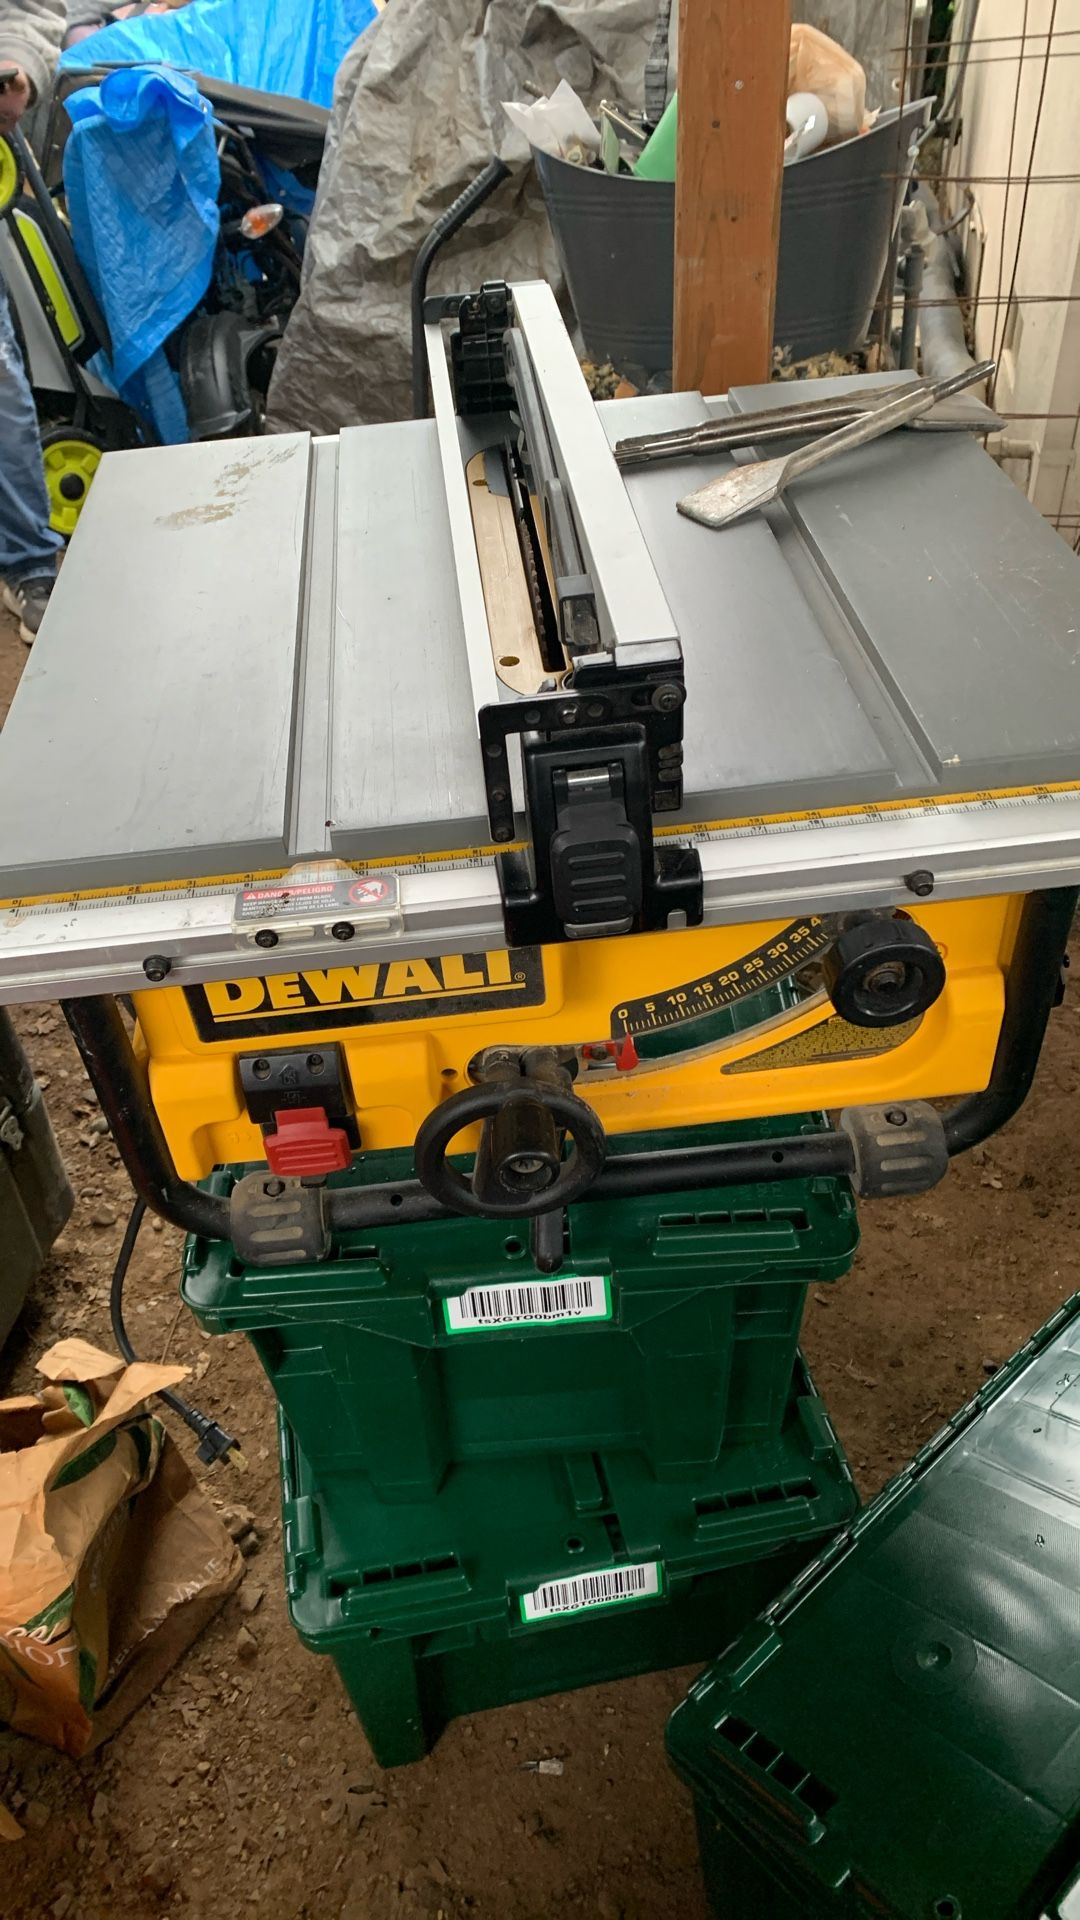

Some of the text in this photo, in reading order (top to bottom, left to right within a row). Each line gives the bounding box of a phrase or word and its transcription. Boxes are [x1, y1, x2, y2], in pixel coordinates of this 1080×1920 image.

[618, 1008, 629, 1019] 0
[645, 1002, 656, 1012] 5
[667, 992, 687, 1006] 10
[693, 983, 714, 995] 15
[718, 970, 740, 986] 20
[743, 957, 764, 973] 25
[767, 942, 789, 959] 30
[789, 925, 810, 943] 35
